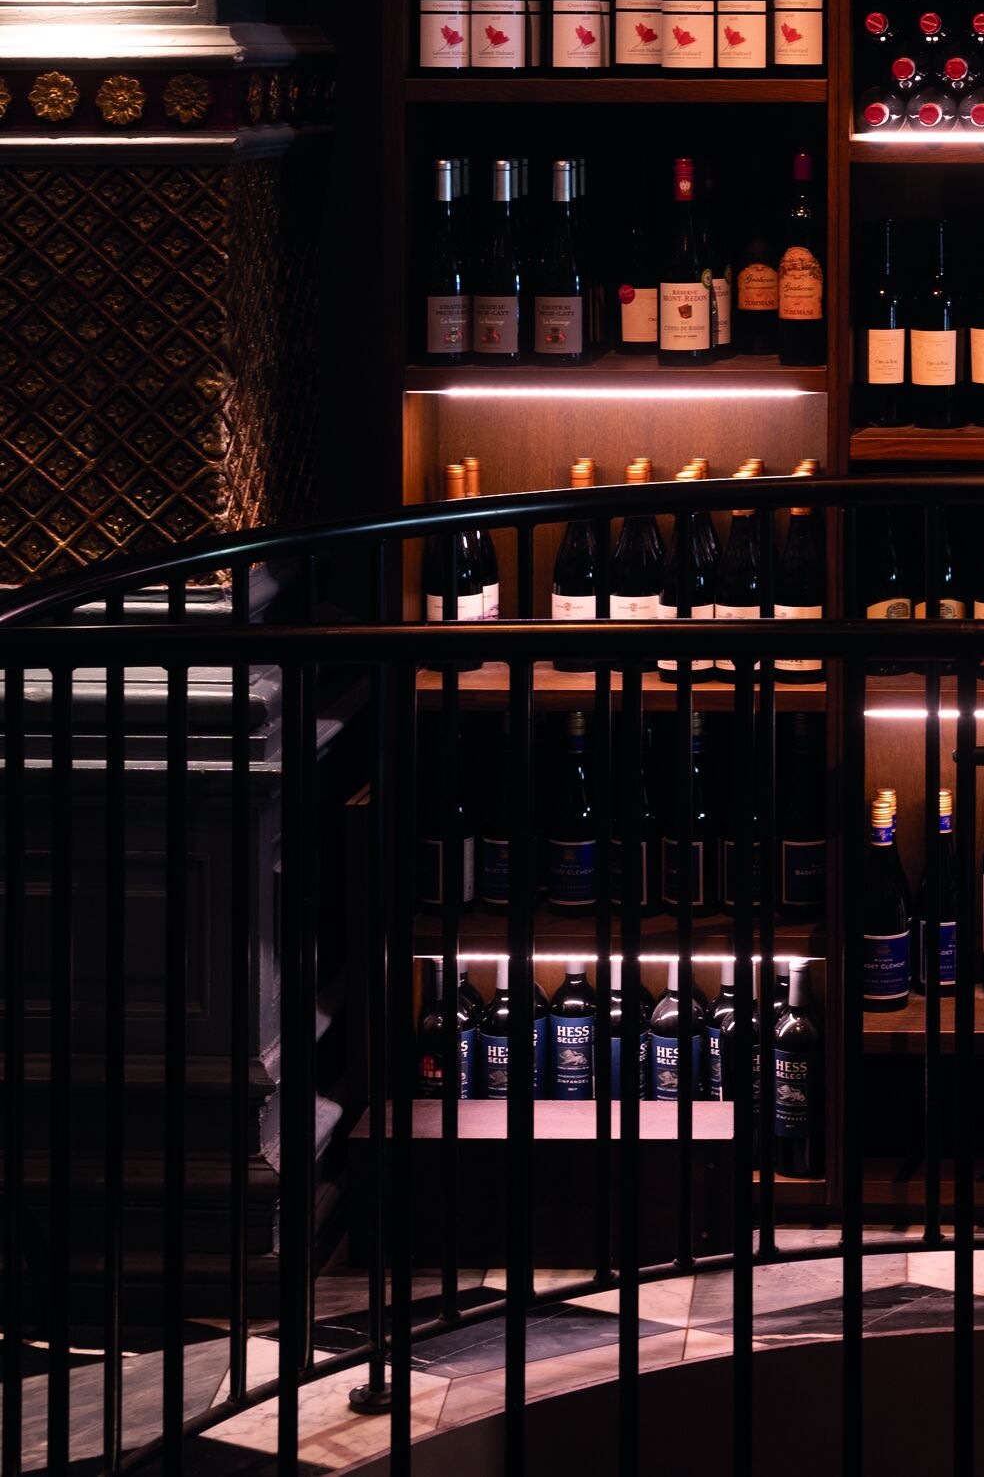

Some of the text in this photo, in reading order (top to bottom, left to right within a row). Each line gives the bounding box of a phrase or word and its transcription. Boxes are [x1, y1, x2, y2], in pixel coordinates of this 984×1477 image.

[557, 1025, 590, 1038] HESS
[557, 1036, 590, 1044] SELECT
[656, 1045, 678, 1057] HES
[656, 1056, 678, 1065] SELE
[776, 1059, 808, 1073] HESS
[776, 1071, 808, 1080] SELECT
